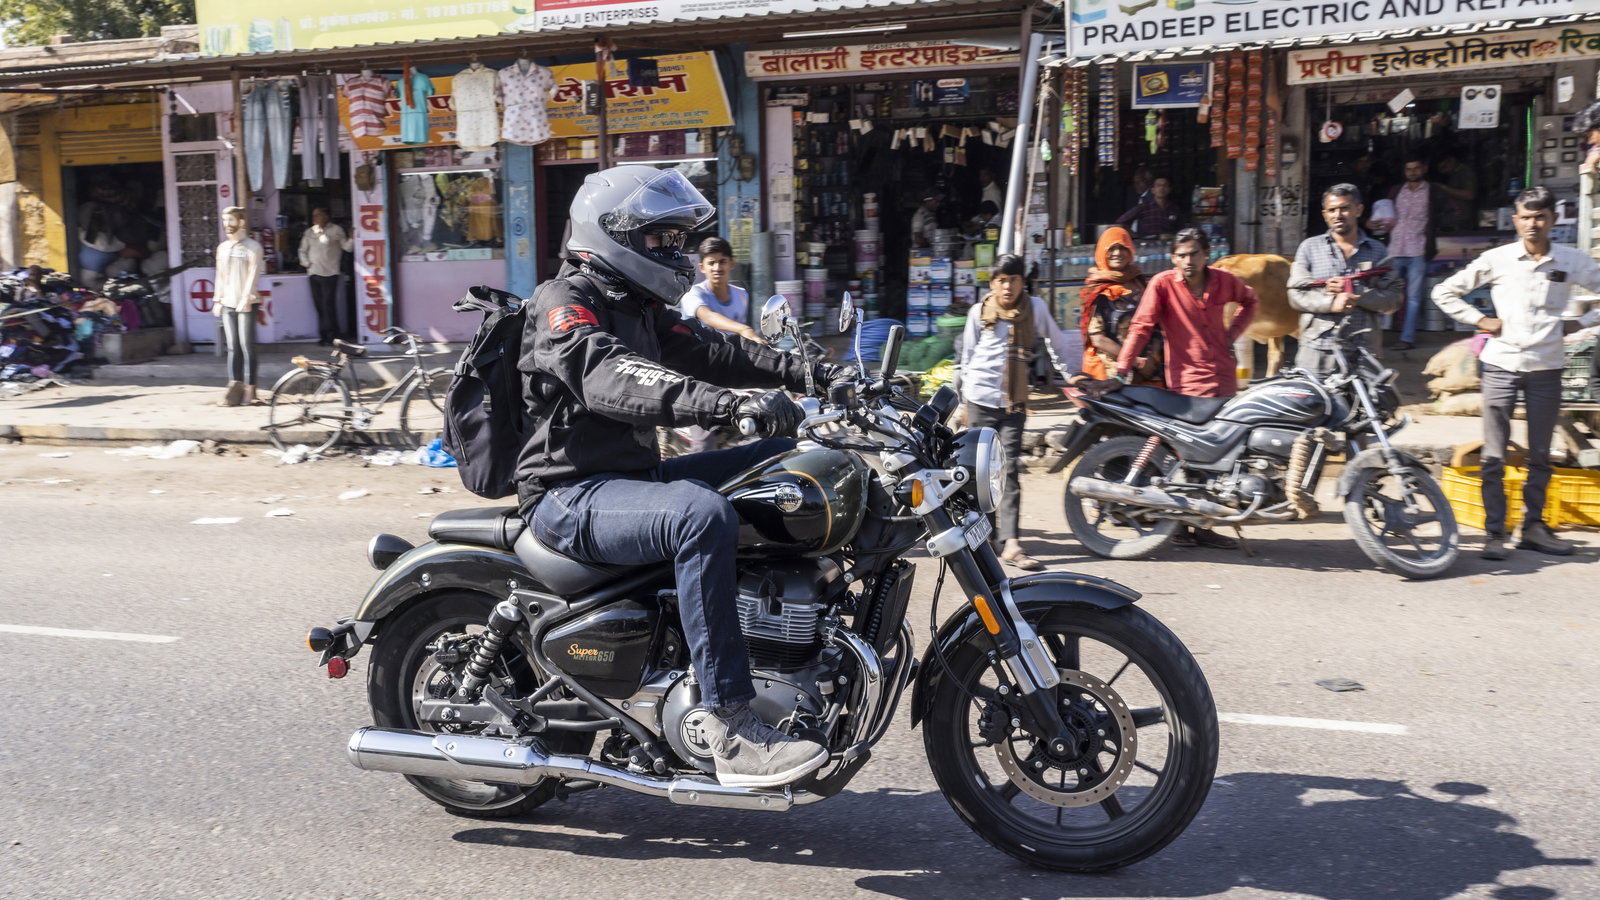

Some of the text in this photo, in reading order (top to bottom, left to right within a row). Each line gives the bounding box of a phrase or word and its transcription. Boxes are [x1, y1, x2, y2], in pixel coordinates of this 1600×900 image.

[542, 7, 659, 26] BALAJI ENTERPRISES
[1083, 0, 1445, 46] PRADEEP ELECTRIC AND
[759, 46, 849, 73] बालाजी
[1296, 50, 1367, 79] प्रदीप
[567, 643, 598, 657] Super
[597, 651, 615, 662] 650
